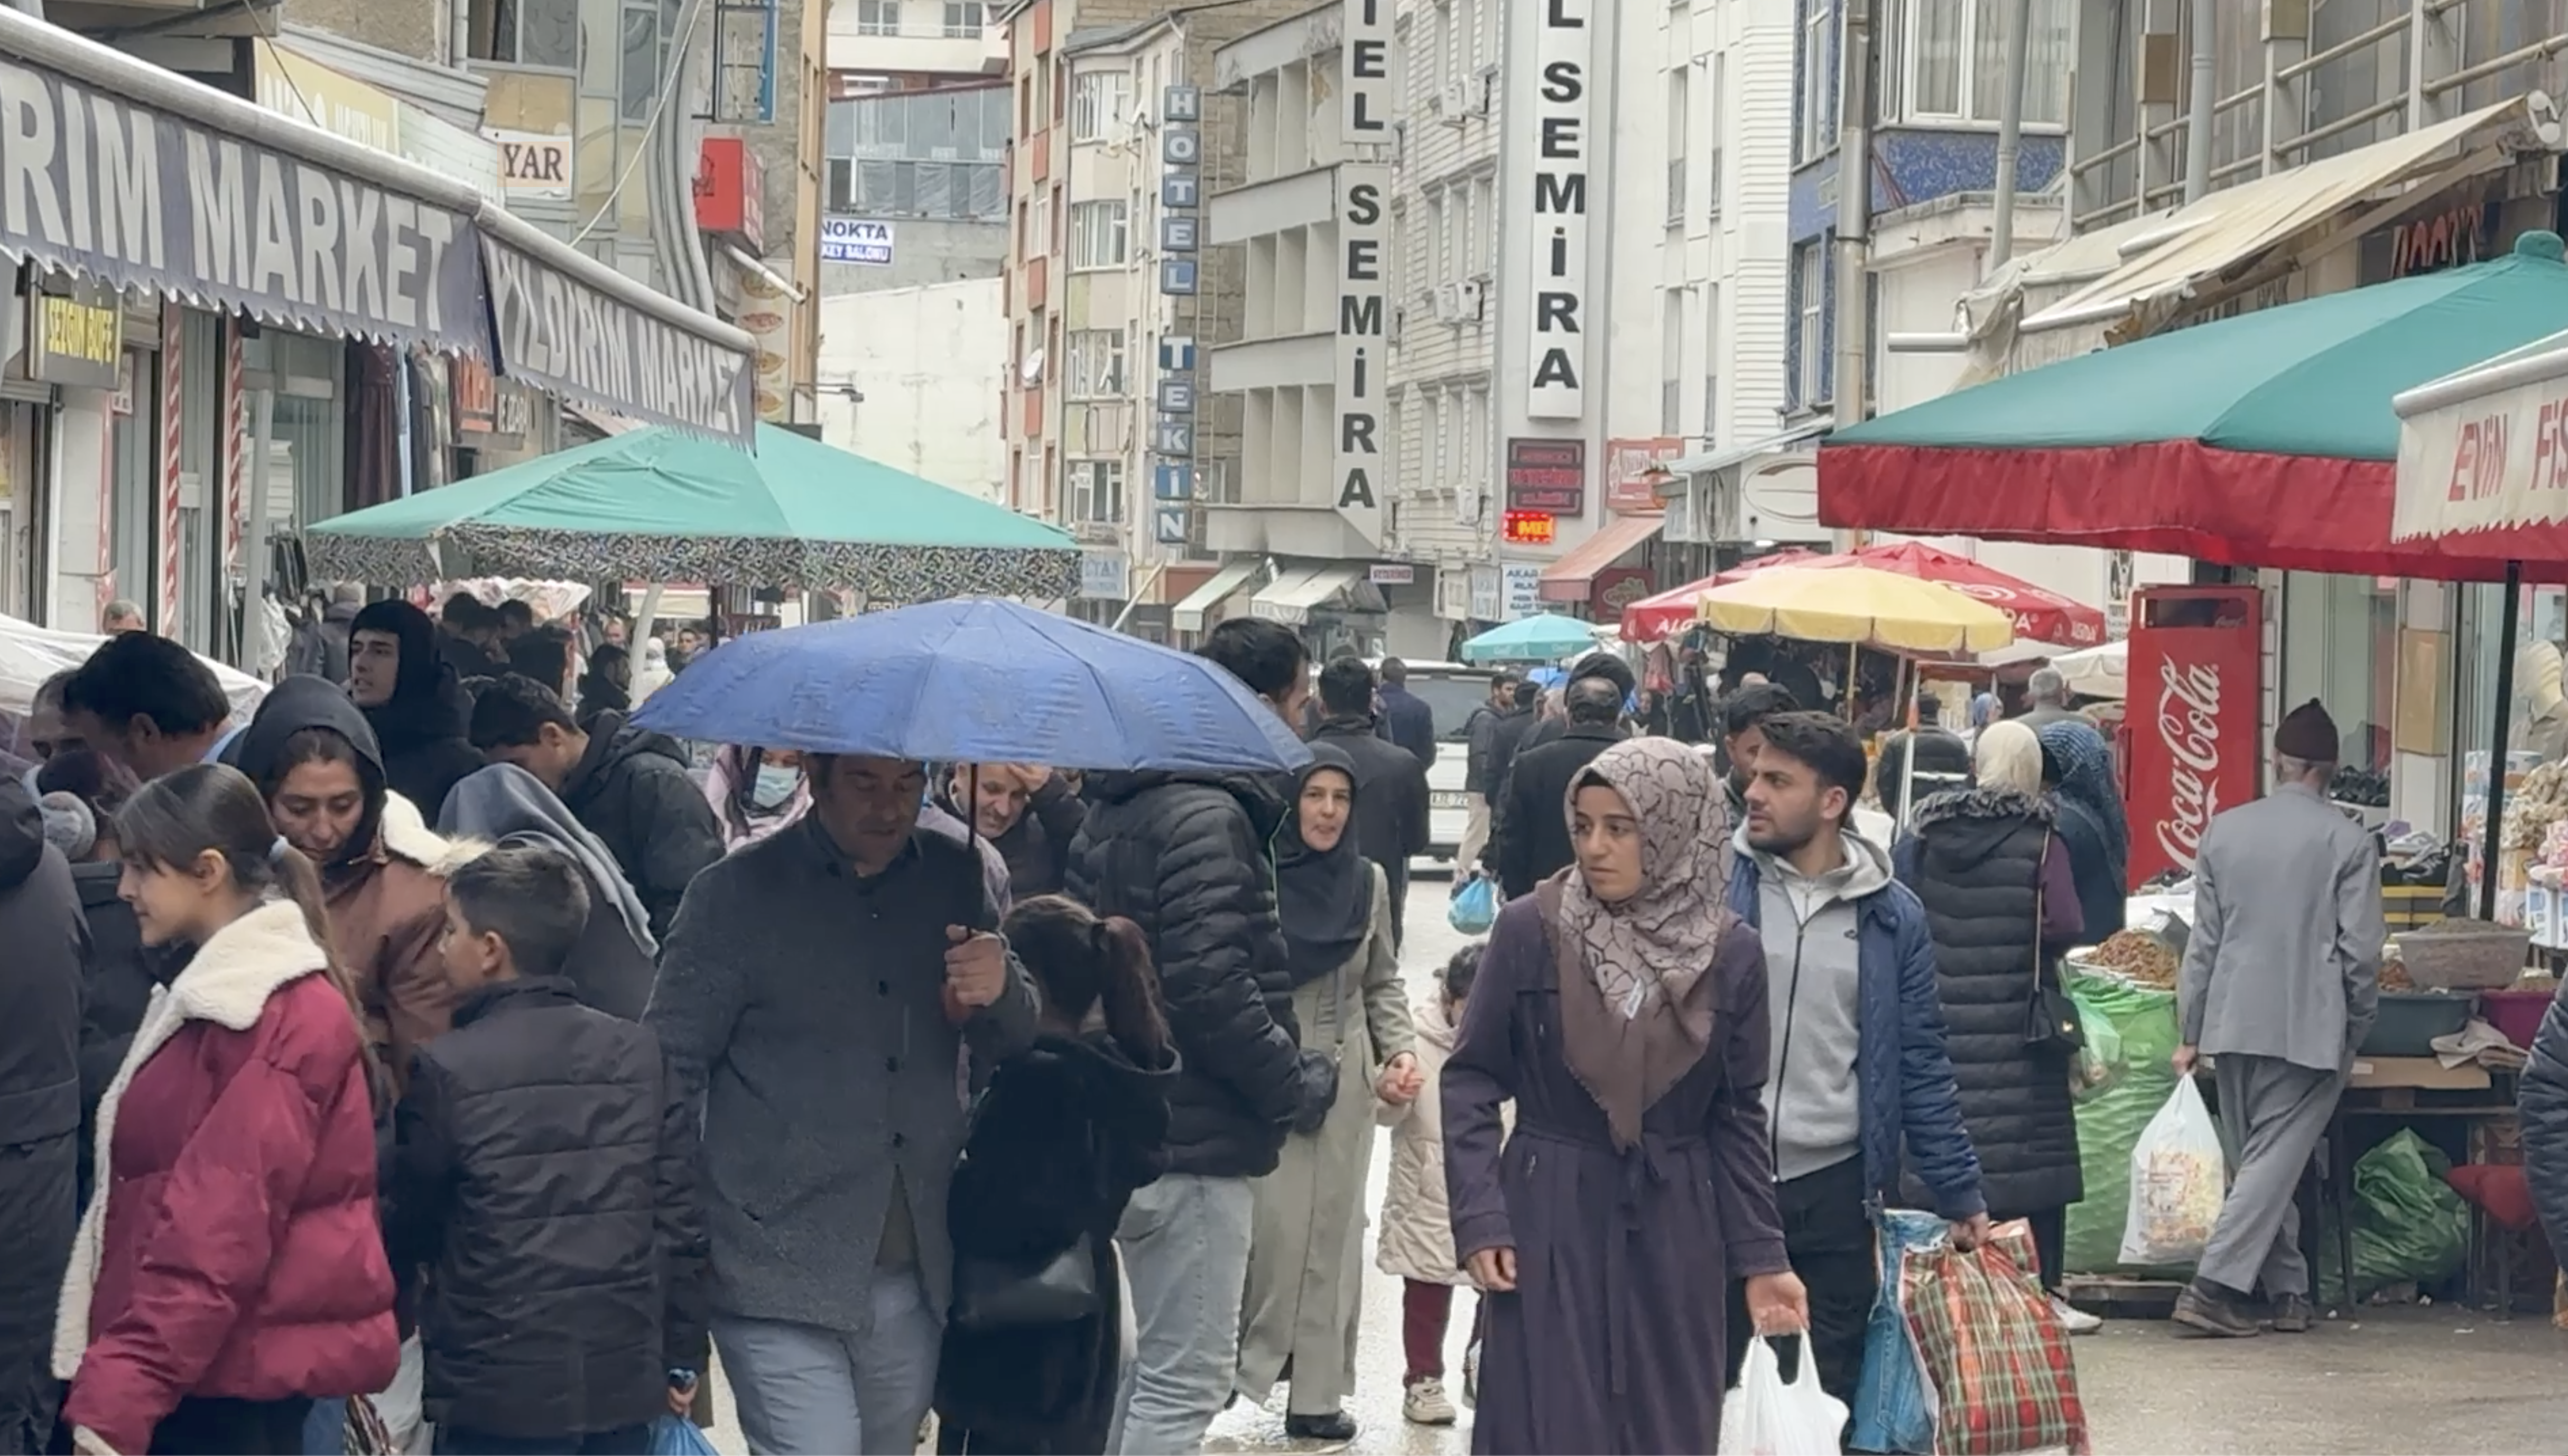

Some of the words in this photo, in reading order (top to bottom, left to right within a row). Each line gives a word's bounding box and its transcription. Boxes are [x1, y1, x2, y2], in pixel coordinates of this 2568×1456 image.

[185, 128, 452, 332] MARKET
[503, 143, 563, 182] YAR
[822, 221, 888, 240] NOKTA
[1166, 92, 1194, 289] HOTEL
[1533, 62, 1587, 390] SEMİRA
[485, 236, 633, 404] YILDIRIM
[637, 314, 746, 435] MARKET
[1339, 184, 1382, 508] SEMİRA
[1160, 336, 1193, 539] TEKİN
